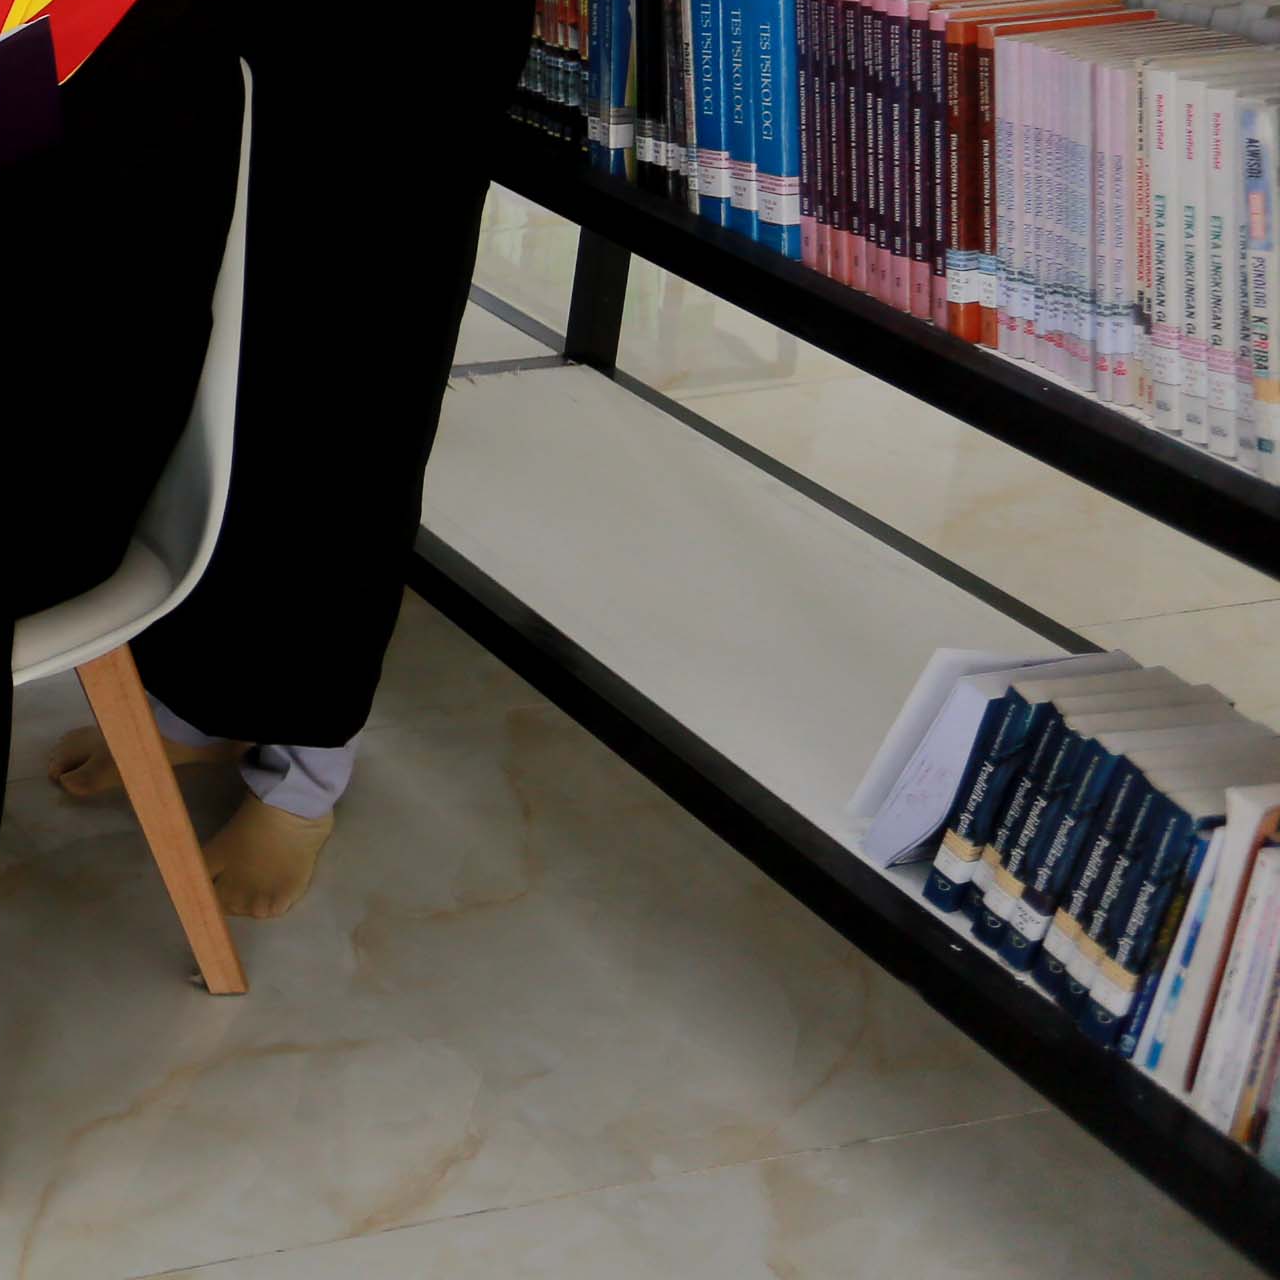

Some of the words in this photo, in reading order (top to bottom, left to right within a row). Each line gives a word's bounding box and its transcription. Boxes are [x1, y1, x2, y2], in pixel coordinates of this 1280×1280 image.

[700, 1, 711, 27] TES
[729, 7, 740, 35] TES
[759, 22, 770, 49] TES
[701, 32, 713, 115] PSIKOLOGI
[731, 39, 744, 124] PSIKOLOGI
[760, 55, 773, 140] PSIKOLOGI
[1245, 137, 1263, 178] ALWISOL
[1154, 195, 1166, 227] ETIKA
[1184, 206, 1194, 238] ETIKA
[1210, 216, 1221, 249] ETIKA
[1153, 233, 1165, 306] LINGKUNGAN
[1184, 244, 1194, 318] LINGKUNGAN
[1211, 255, 1221, 329] LINGKUNGAN
[1249, 256, 1269, 308] PSIKOLOGI
[967, 761, 994, 812] Pendidikan
[1018, 796, 1047, 847] Pendidikan
[1044, 815, 1074, 866] Pendidikan
[1080, 835, 1110, 889] Pendidikan
[1100, 855, 1130, 908] Pendidikan
[1125, 881, 1156, 935] Pendidikan
